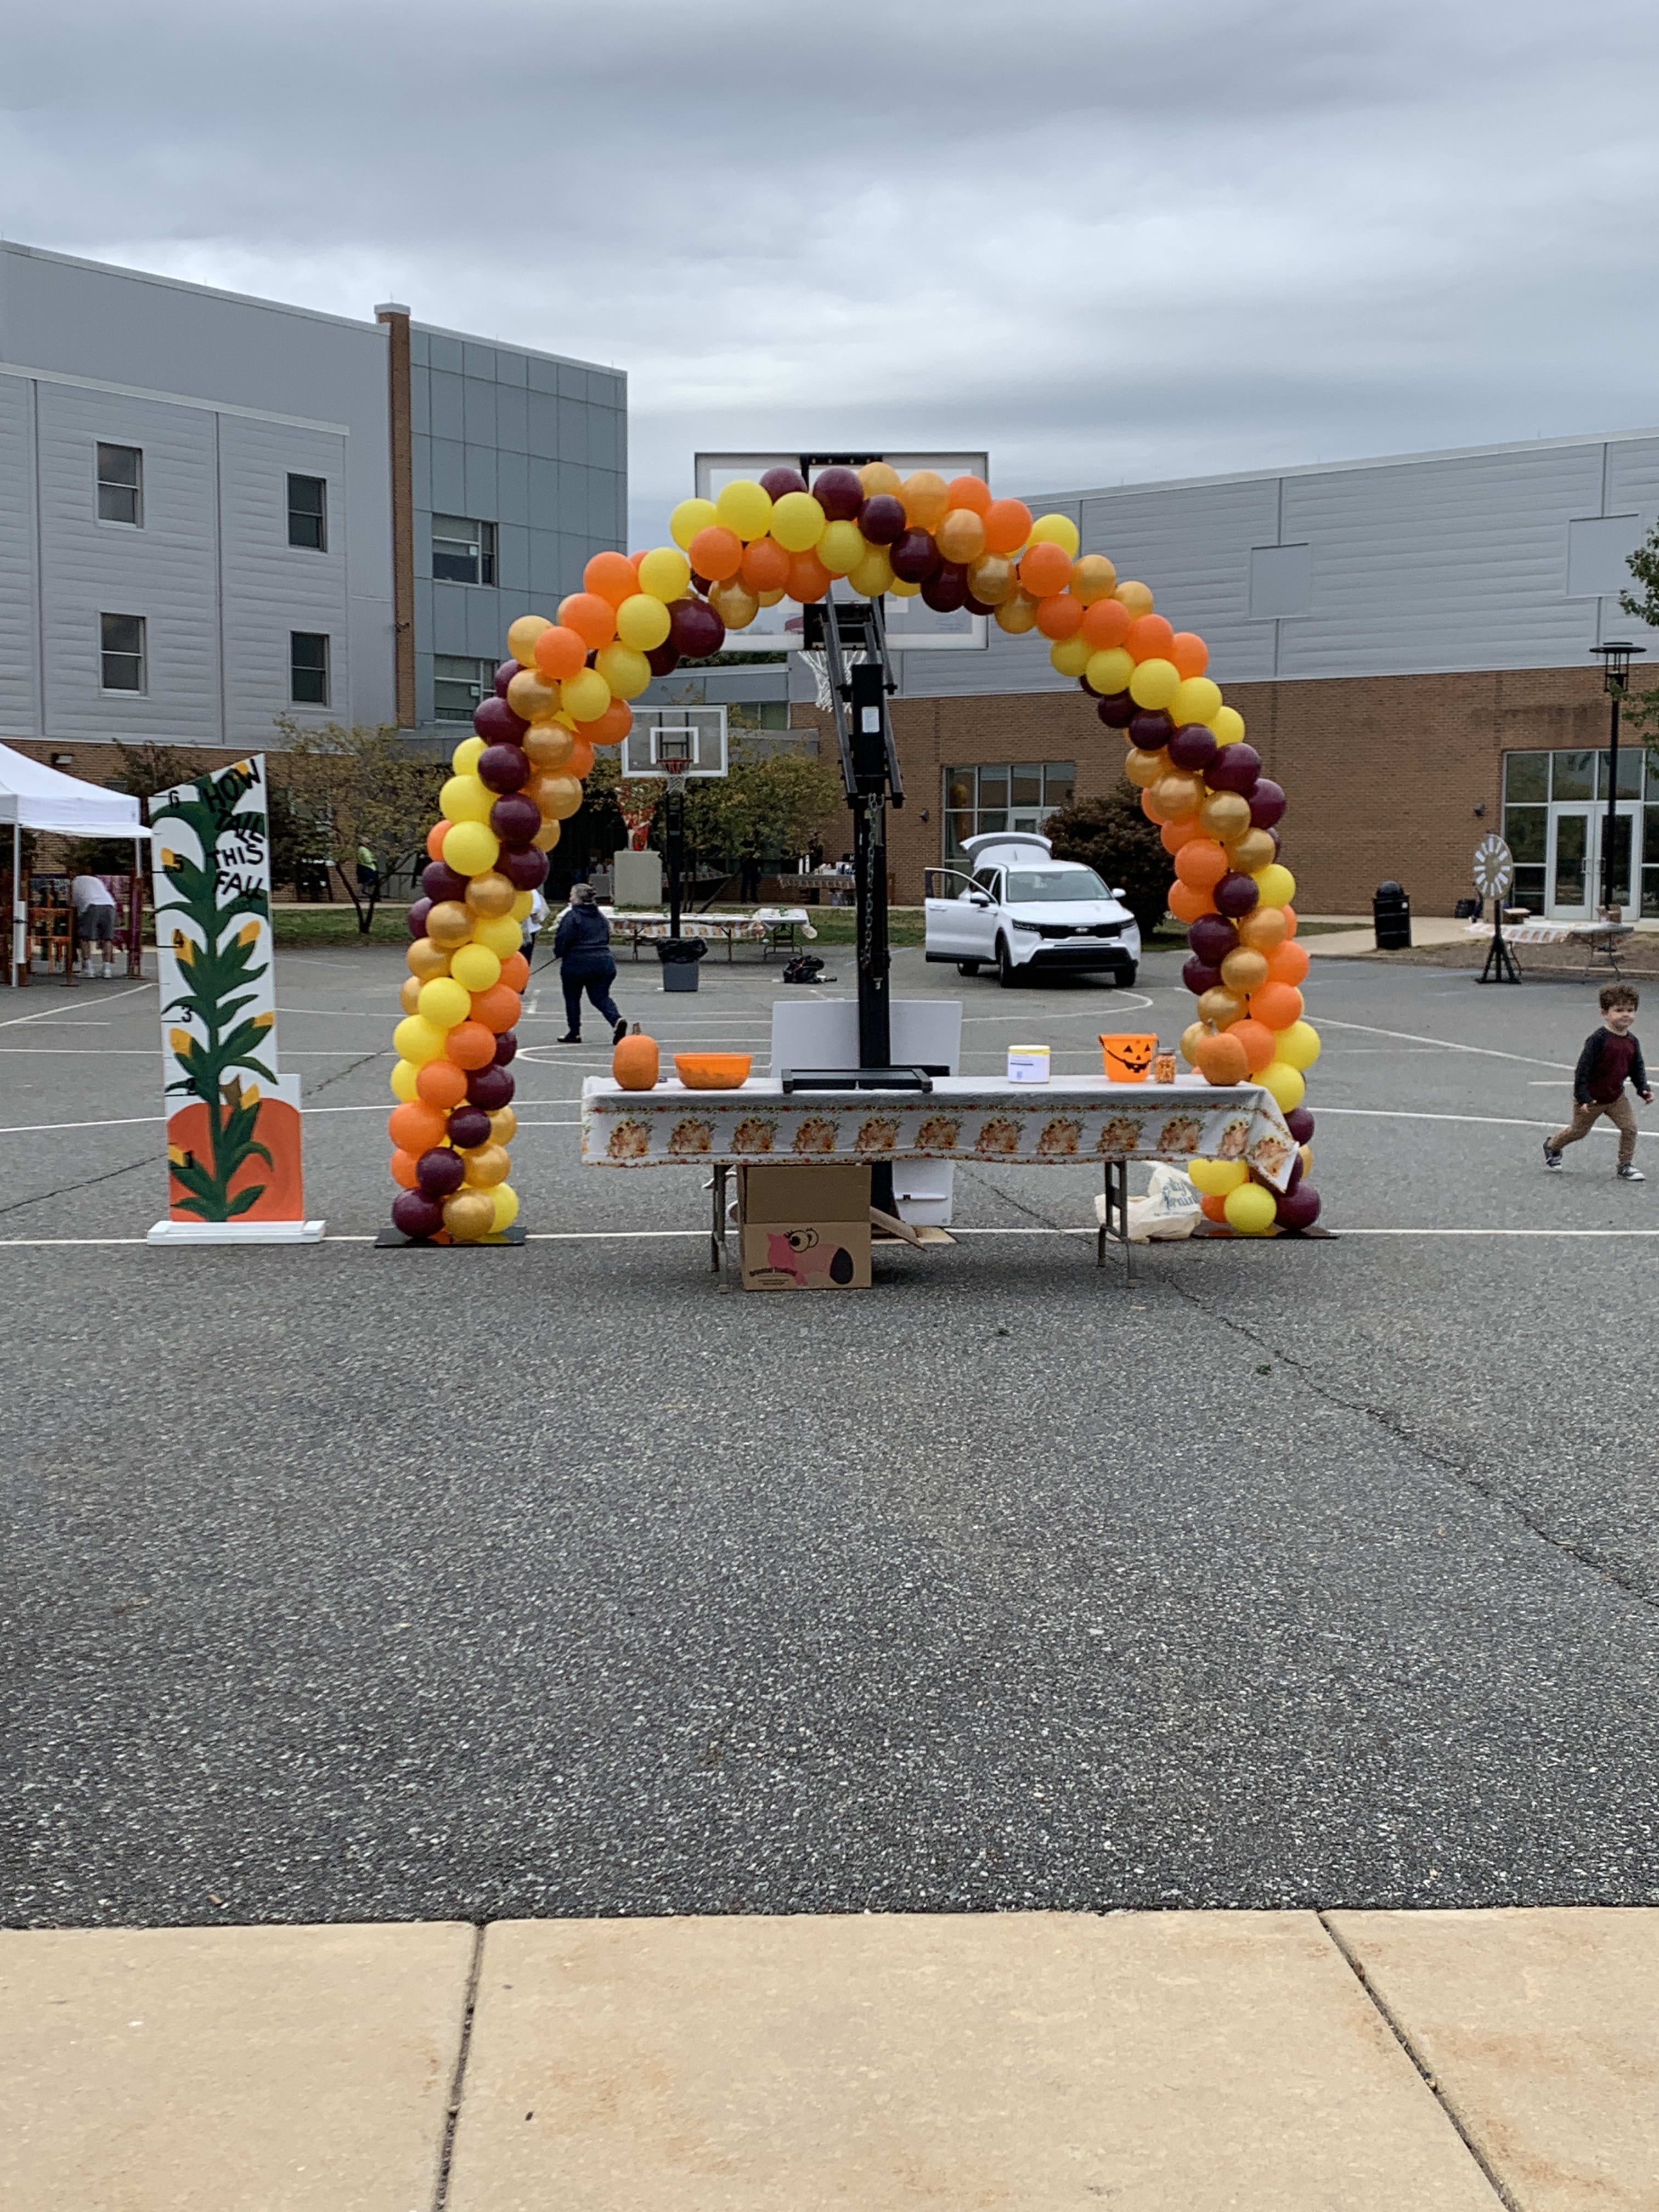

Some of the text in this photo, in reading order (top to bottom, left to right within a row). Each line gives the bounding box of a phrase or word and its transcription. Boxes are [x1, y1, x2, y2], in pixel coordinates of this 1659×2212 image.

[170, 790, 180, 808] 6
[202, 758, 261, 812] HOW
[215, 809, 264, 845] TALL
[206, 843, 264, 869] THIS
[213, 870, 263, 900] FALL
[181, 1004, 192, 1023] 3
